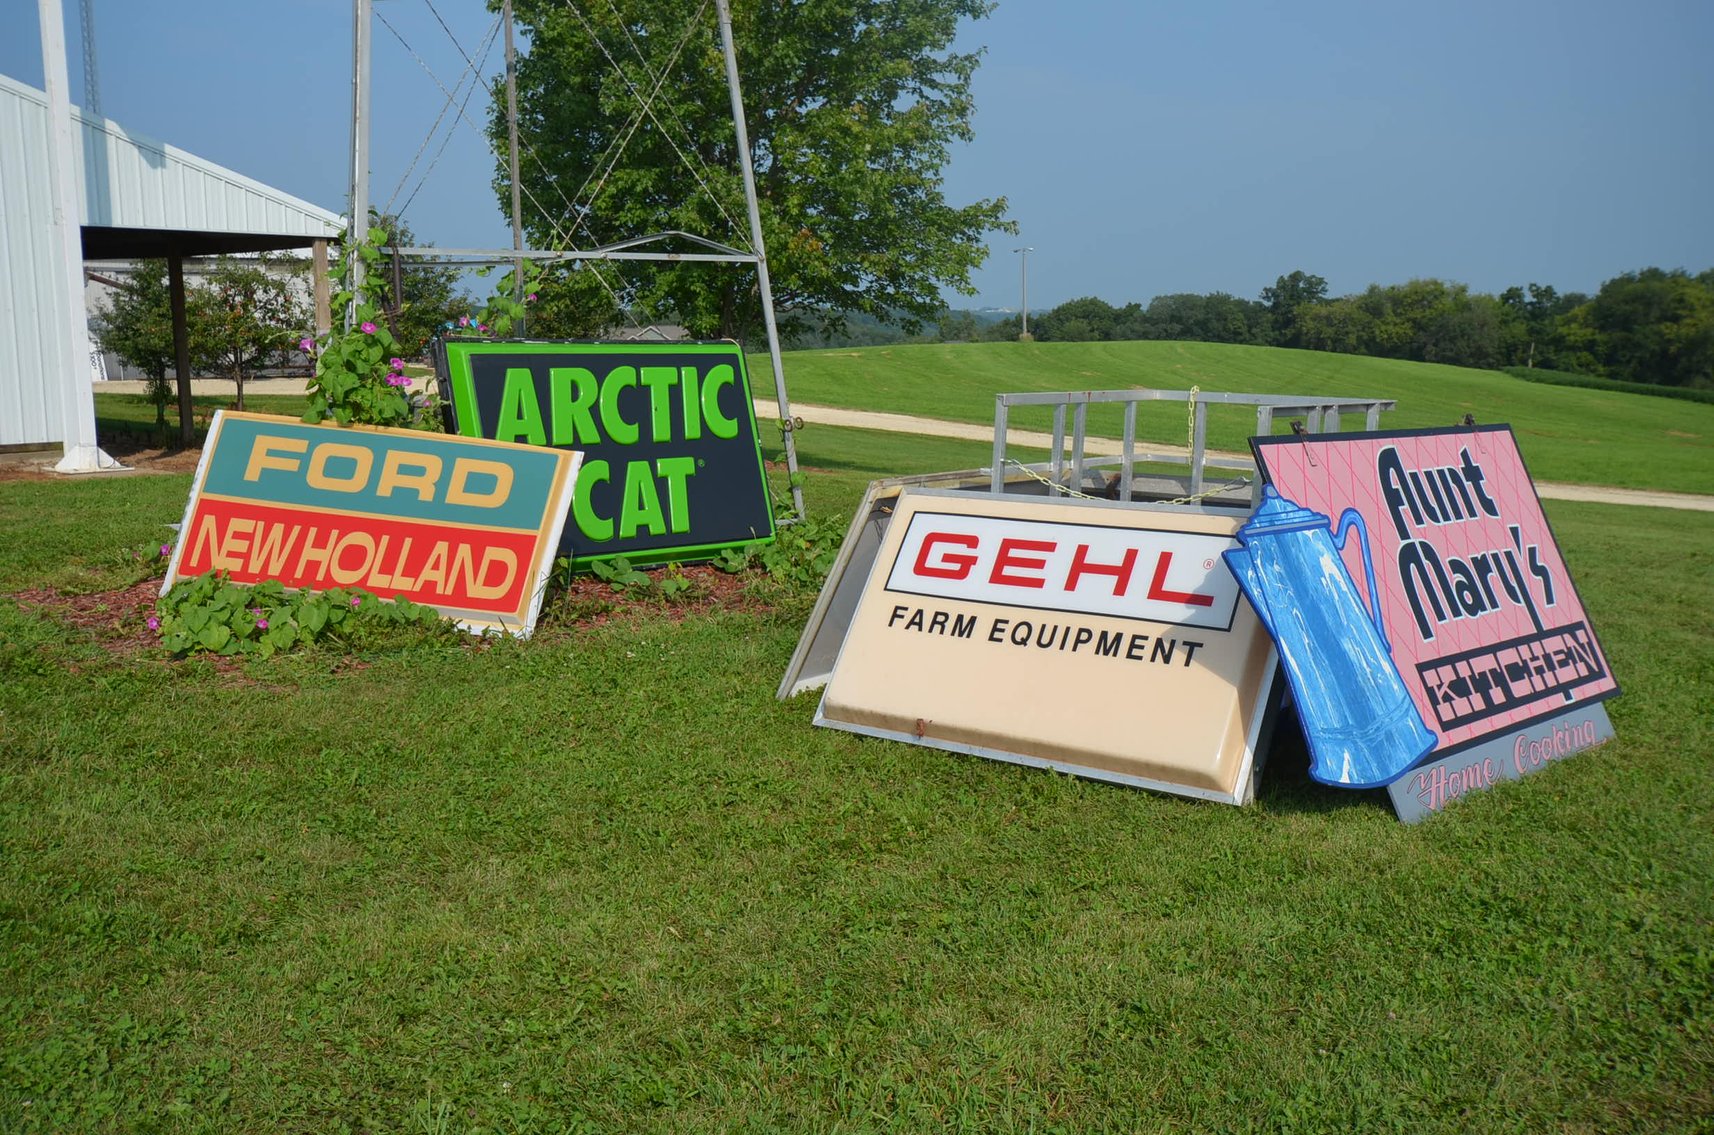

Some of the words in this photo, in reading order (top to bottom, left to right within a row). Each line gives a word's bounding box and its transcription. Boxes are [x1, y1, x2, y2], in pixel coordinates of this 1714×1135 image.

[497, 365, 739, 445] ARCTIC
[244, 434, 515, 508] FORD
[572, 457, 696, 541] CAT
[1376, 445, 1500, 542] Aunt
[294, 526, 518, 599] HOLLAND
[913, 532, 1215, 606] GEHL
[1398, 525, 1556, 642] Mary's
[888, 606, 978, 640] FARM
[988, 619, 1204, 667] EQUIPMENT
[1422, 629, 1600, 723] KITCHEN
[1406, 756, 1503, 811] Home
[1514, 719, 1607, 774] Cooking
